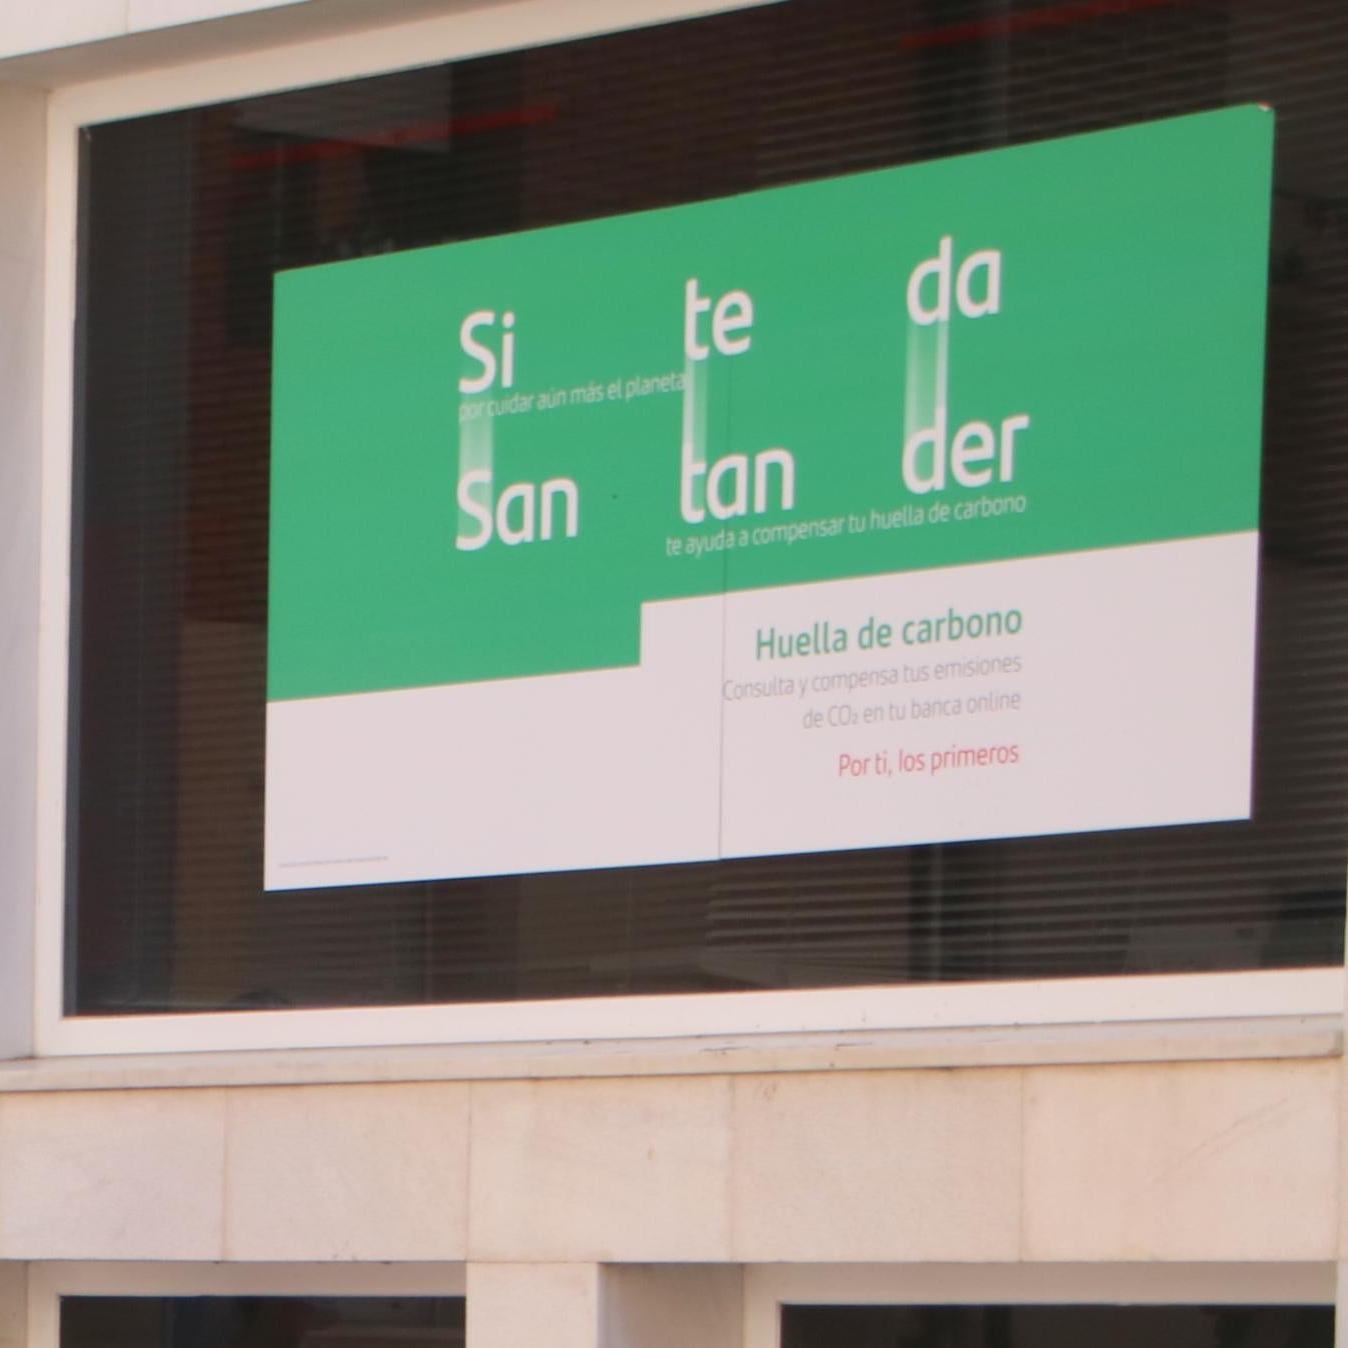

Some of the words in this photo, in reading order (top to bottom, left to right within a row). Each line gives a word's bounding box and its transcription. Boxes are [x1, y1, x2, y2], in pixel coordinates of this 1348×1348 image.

[907, 235, 1001, 325] da
[458, 310, 515, 393] Si
[684, 278, 753, 360] te
[459, 401, 485, 422] por
[487, 392, 533, 416] cuidar
[537, 387, 566, 410] aún
[570, 381, 603, 404] más
[608, 378, 622, 399] el
[626, 372, 685, 400] planeta
[680, 440, 794, 524] tan
[902, 404, 1029, 495] der
[456, 469, 578, 551] San
[666, 536, 682, 556] te
[686, 529, 735, 558] ayuda
[738, 531, 748, 546] a
[753, 515, 844, 545] compensar
[848, 513, 865, 533] tu
[871, 503, 923, 531] huella
[928, 500, 949, 522] de
[954, 493, 1027, 520] carbono
[755, 621, 848, 660] Huella
[858, 616, 892, 650] de
[902, 607, 1023, 645] carbono
[723, 676, 793, 700] Consulta
[798, 679, 808, 699] y
[811, 666, 898, 693] compensa
[904, 664, 930, 683] tus
[935, 655, 1022, 680] emisiones
[803, 708, 823, 729] de
[864, 707, 883, 724] en
[889, 703, 905, 722] tu
[912, 697, 961, 720] banca
[967, 692, 1021, 714] online
[839, 753, 870, 777] Por
[874, 749, 892, 777] ti,
[899, 749, 925, 773] los
[931, 744, 1019, 775] primeros
